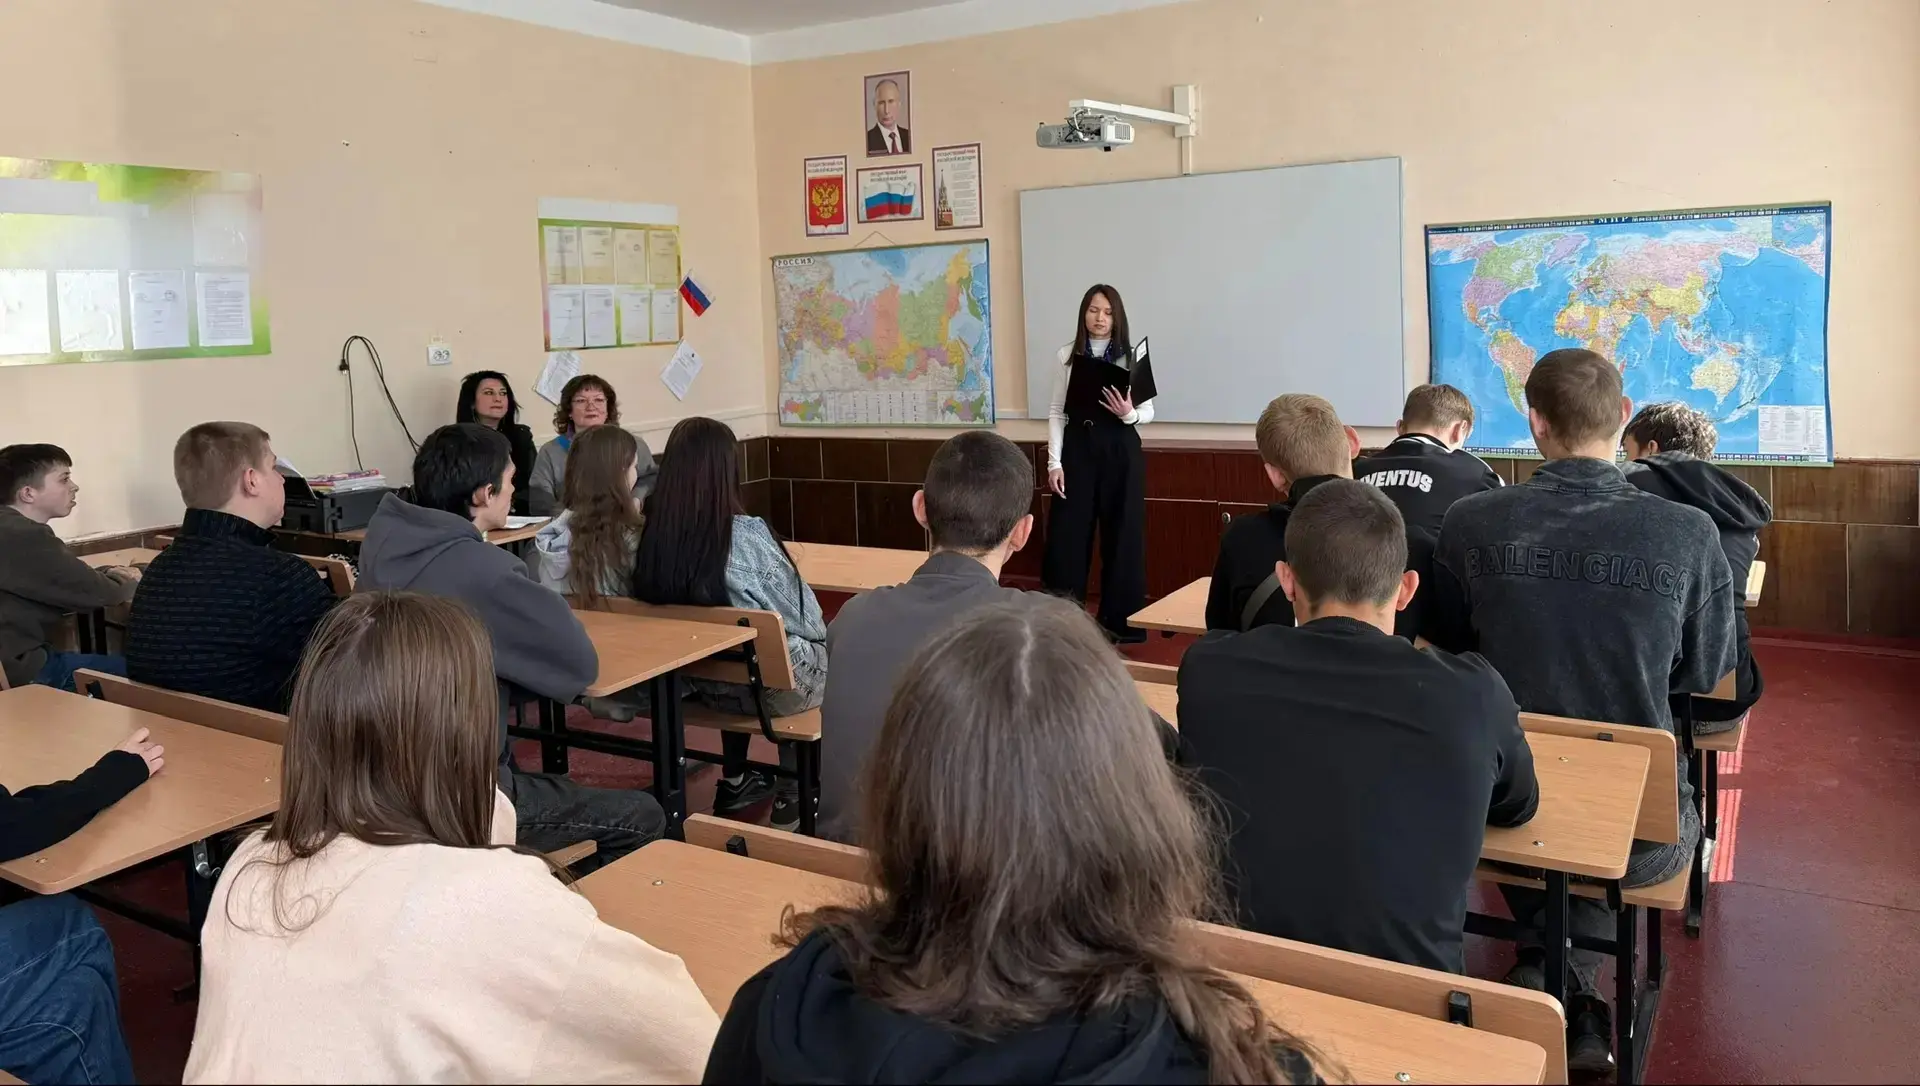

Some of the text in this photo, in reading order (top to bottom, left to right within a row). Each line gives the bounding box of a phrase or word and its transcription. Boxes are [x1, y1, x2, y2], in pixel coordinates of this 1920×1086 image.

[778, 258, 812, 266] РОССИЯ
[1360, 469, 1433, 492] VENTUS
[1466, 544, 1691, 603] BALENCIAGA
